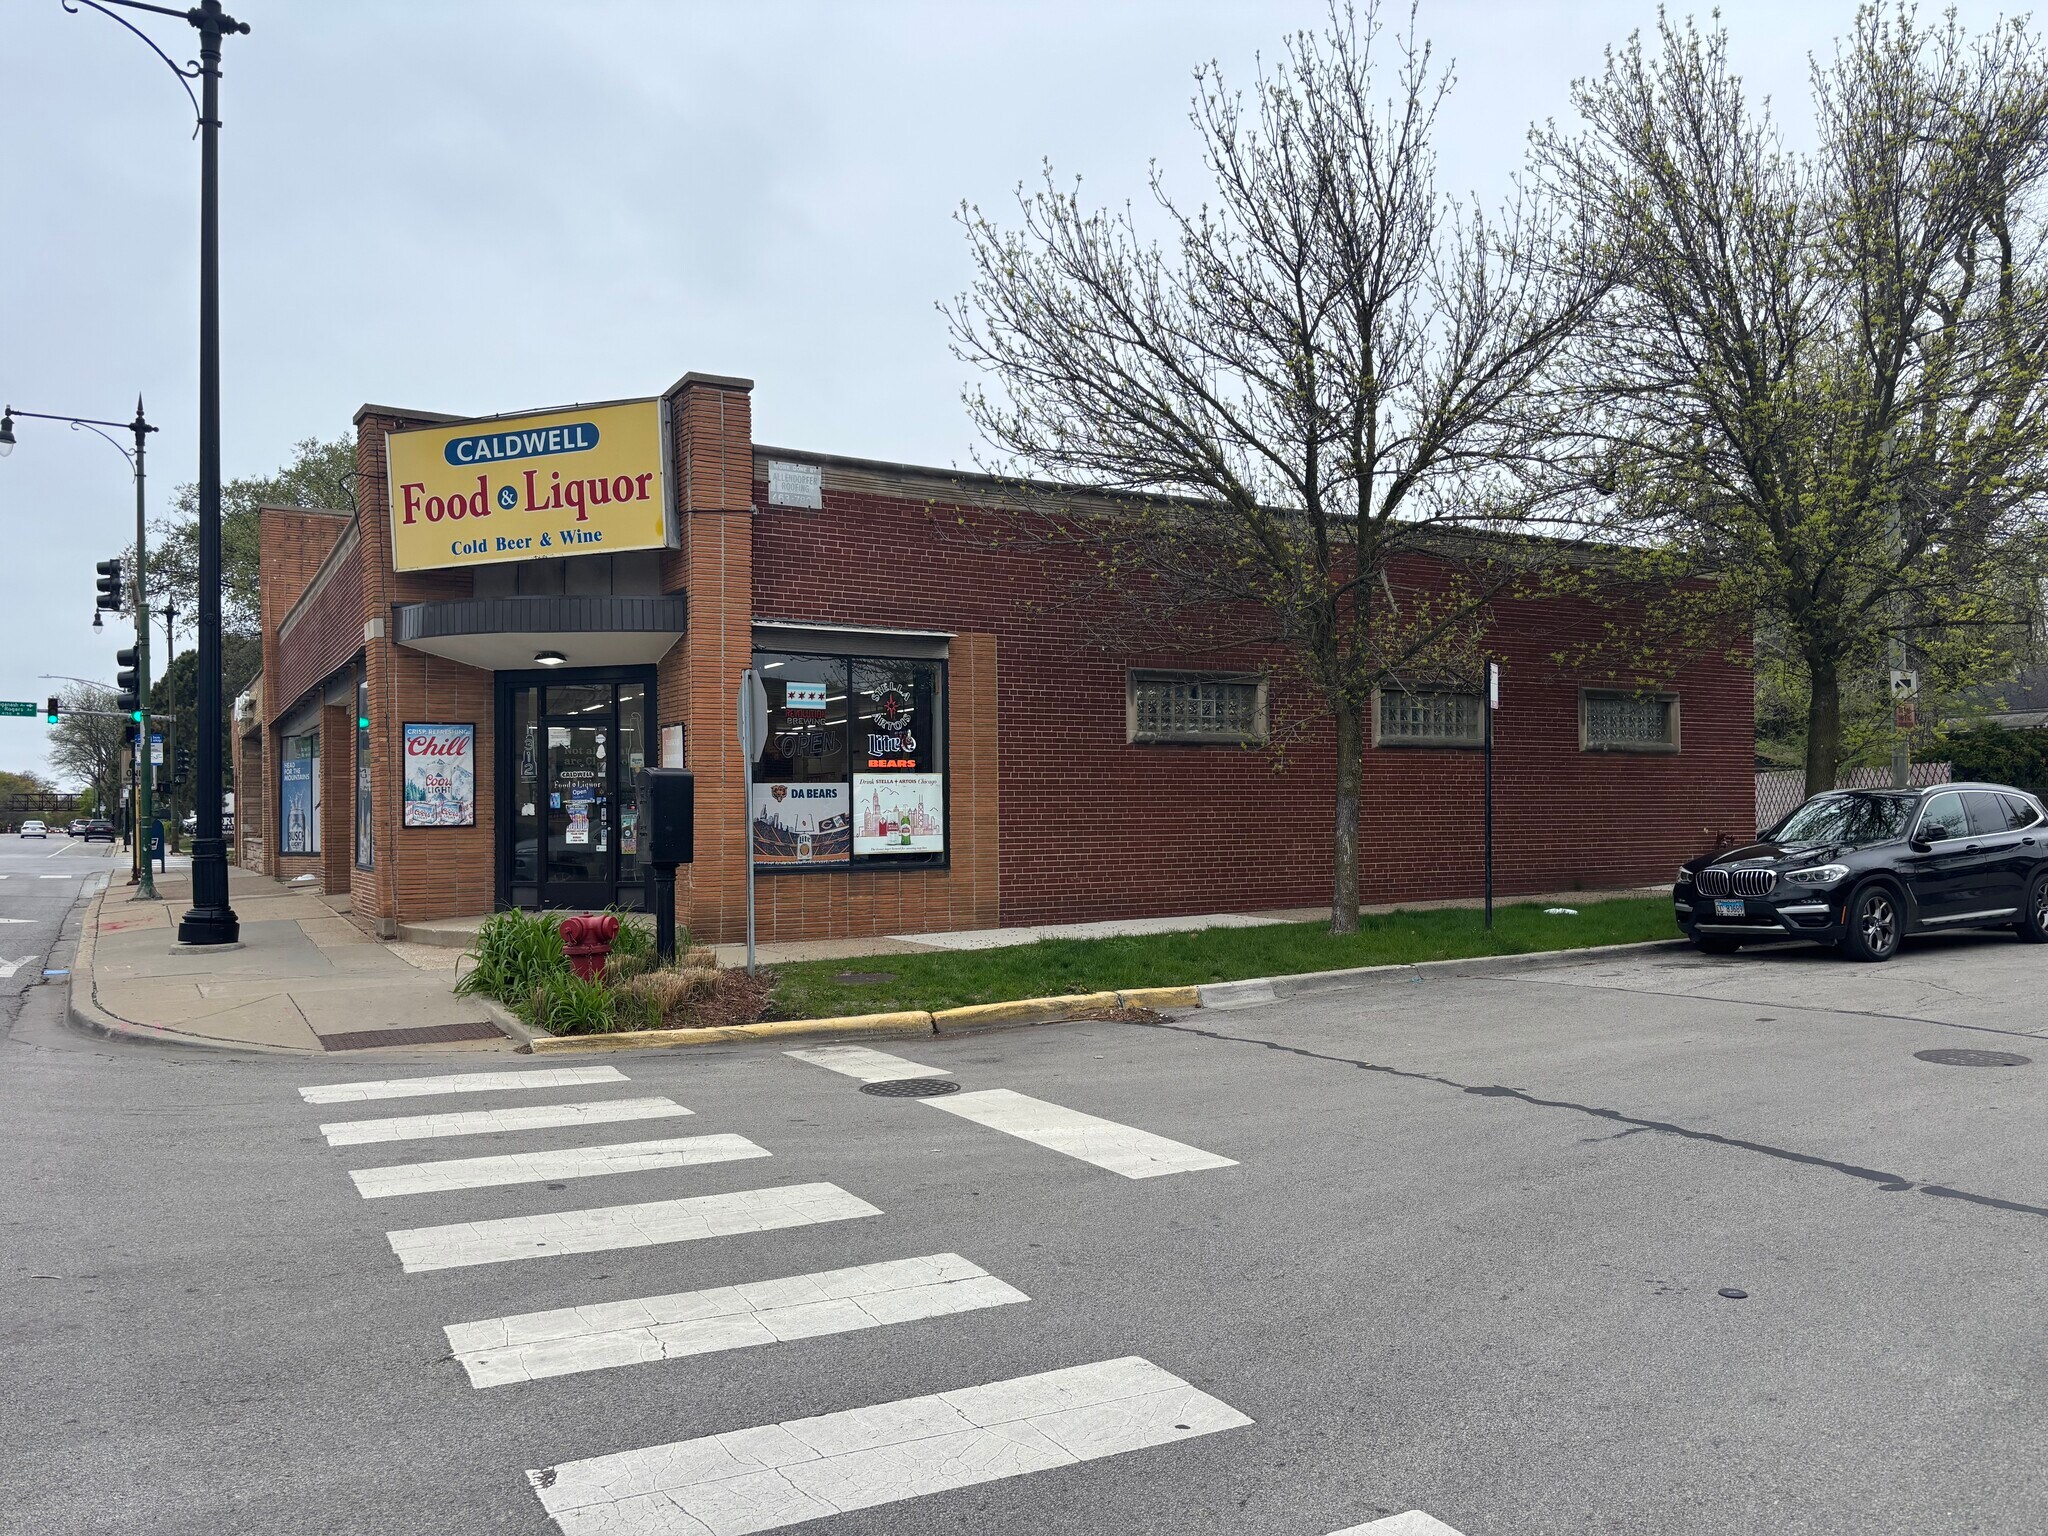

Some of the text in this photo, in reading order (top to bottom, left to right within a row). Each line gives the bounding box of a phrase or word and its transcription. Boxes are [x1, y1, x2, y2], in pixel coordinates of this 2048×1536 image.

[456, 427, 588, 462] CALDWELL
[773, 472, 818, 486] ALLENDORFER
[781, 481, 810, 493] ROOFING
[400, 470, 653, 525] Food & Liquor
[451, 529, 603, 556] Cold Beer & Wine
[871, 681, 911, 703] STELLA
[785, 709, 826, 718] REVOLUTION
[786, 717, 827, 726] BREWING
[871, 712, 912, 731] ARTOIS
[407, 736, 470, 756] Chill
[782, 731, 835, 758] OPEN
[867, 733, 901, 757] Lite
[425, 774, 452, 787] Coors
[553, 780, 571, 789] Food
[577, 780, 602, 791] Liquor
[427, 786, 451, 794] LIGHT
[791, 788, 838, 799] DA BEARS
